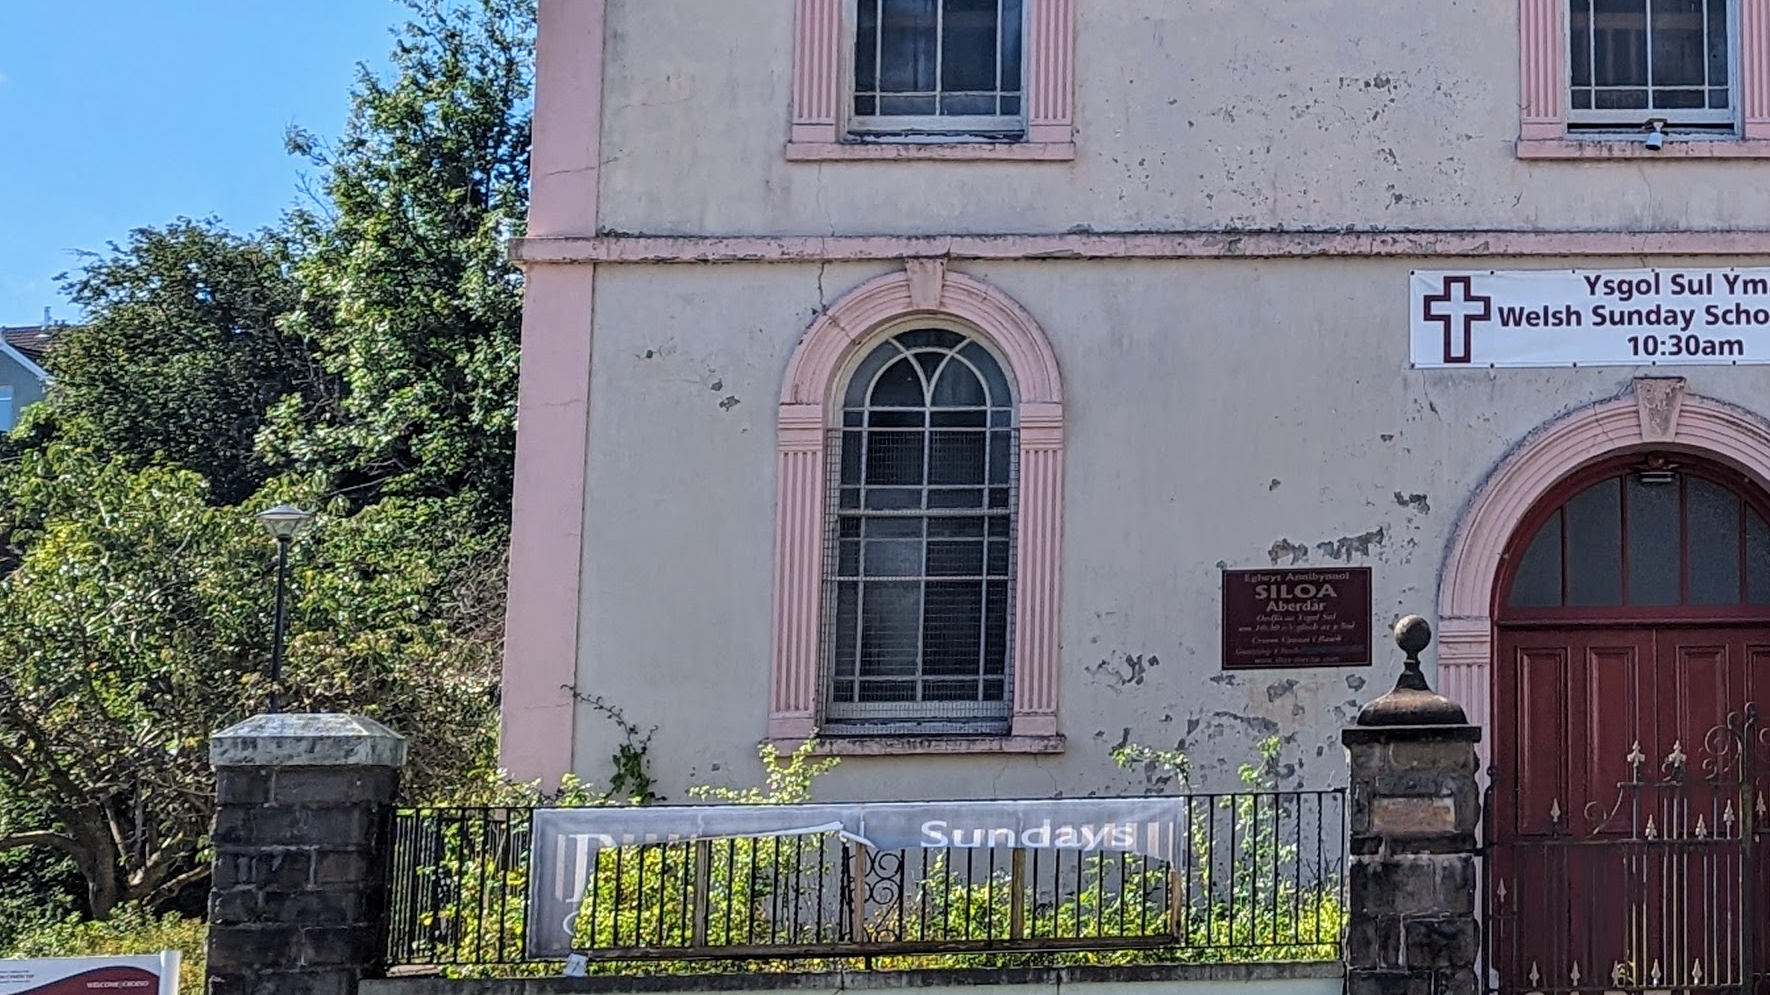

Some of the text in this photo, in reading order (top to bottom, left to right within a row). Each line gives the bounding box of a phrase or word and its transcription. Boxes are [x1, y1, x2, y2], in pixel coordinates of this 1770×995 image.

[1583, 272, 1660, 302] Ysgol
[1671, 273, 1713, 295] Sul
[1498, 305, 1582, 327] Welsh
[1592, 304, 1695, 332] Sunday
[1627, 335, 1744, 356] 10:30am
[1255, 584, 1338, 599] SILOA
[920, 819, 1135, 852] Sundays
